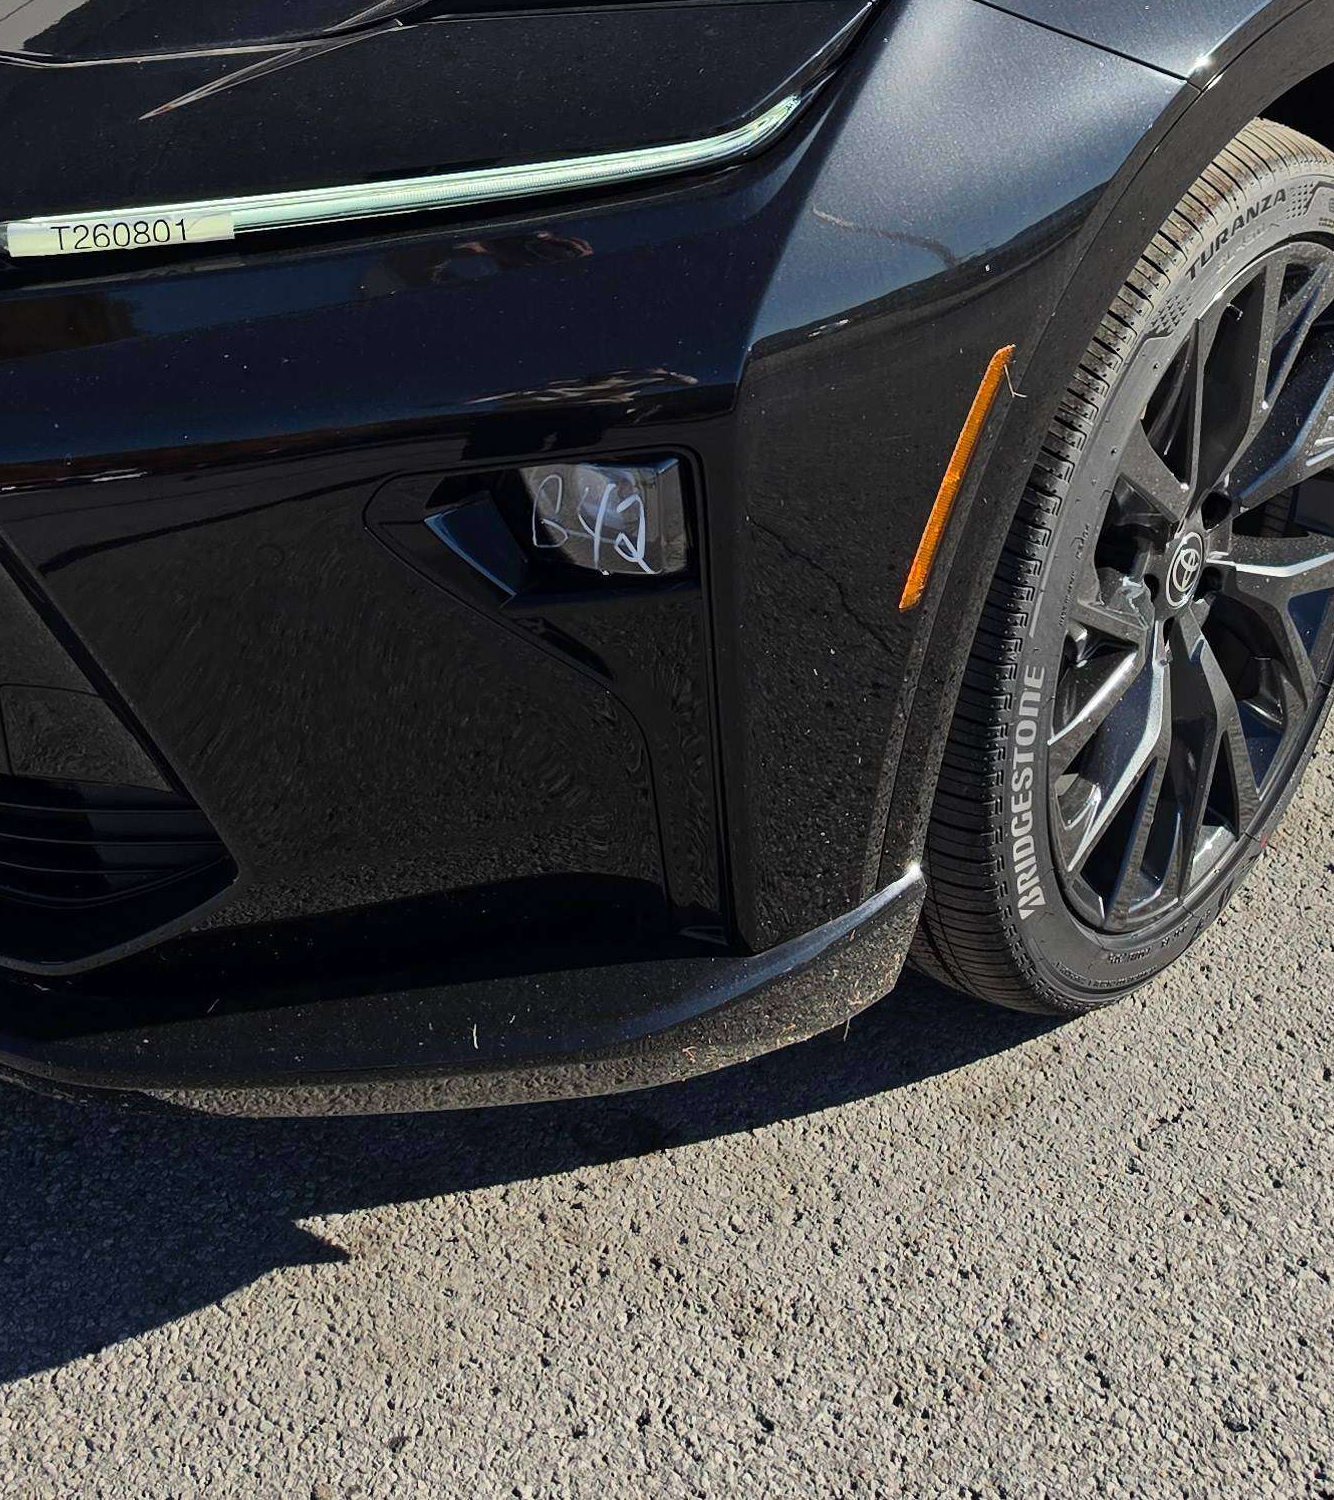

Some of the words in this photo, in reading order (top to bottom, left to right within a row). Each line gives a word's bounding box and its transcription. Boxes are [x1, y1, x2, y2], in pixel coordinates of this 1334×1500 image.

[50, 218, 188, 251] T260801
[1184, 188, 1287, 282] TURANZA
[1010, 664, 1046, 921] BRIDGESTONE
